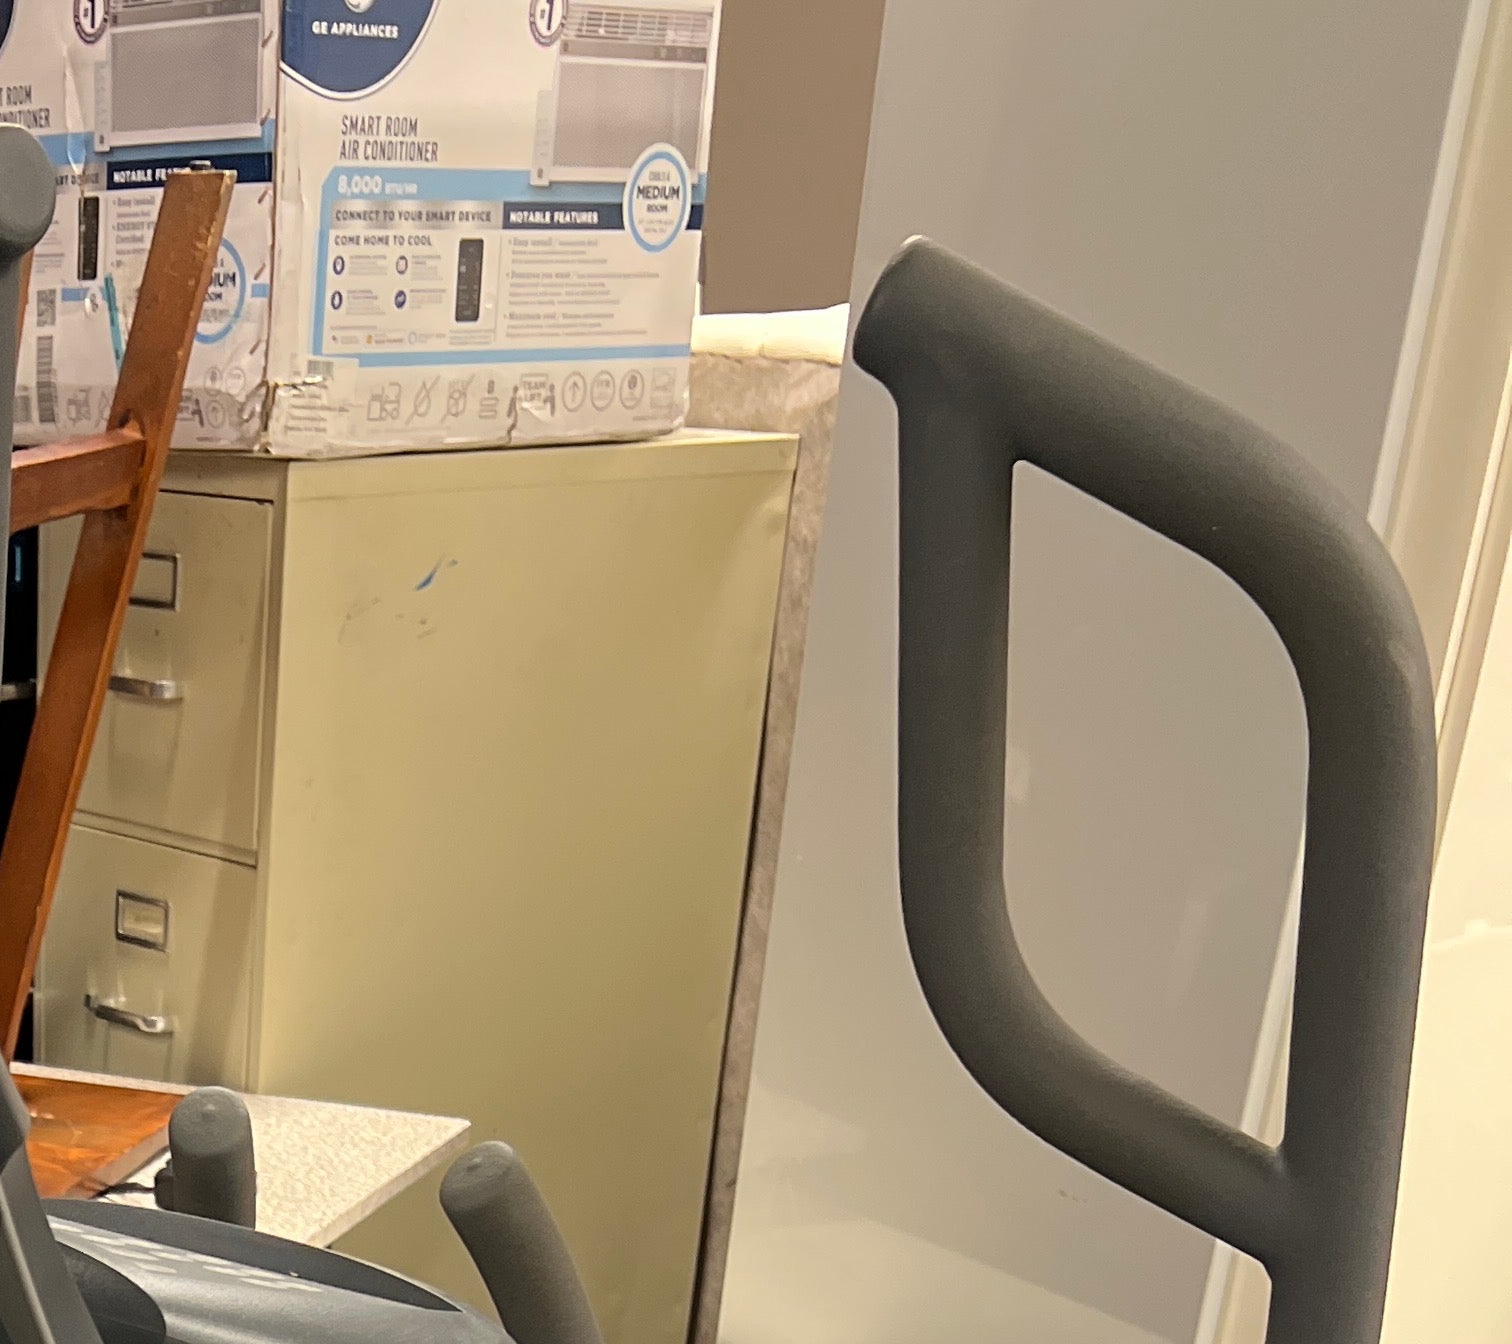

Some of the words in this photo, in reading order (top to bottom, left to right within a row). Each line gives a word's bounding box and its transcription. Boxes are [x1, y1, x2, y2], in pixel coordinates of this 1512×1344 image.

[312, 21, 328, 35] GE
[331, 22, 399, 39] APPLIANCES
[6, 85, 32, 107] ROOM
[341, 114, 382, 137] SMART
[387, 116, 418, 137] ROOM
[339, 140, 359, 161] AIR
[364, 140, 438, 162] CONDITIONER
[113, 168, 152, 183] NOTABLE
[636, 185, 680, 200] MEDIUM
[335, 209, 380, 222] CONNECT
[383, 210, 395, 222] TO
[398, 210, 422, 222] YOUR
[425, 210, 455, 222] SMART
[458, 211, 491, 223] DEVICE
[509, 211, 551, 224] NOTABLE
[554, 211, 599, 224] FEATURES
[334, 235, 360, 247] COME
[363, 235, 389, 247] HOME
[393, 235, 405, 247] TO
[408, 235, 432, 247] COOL
